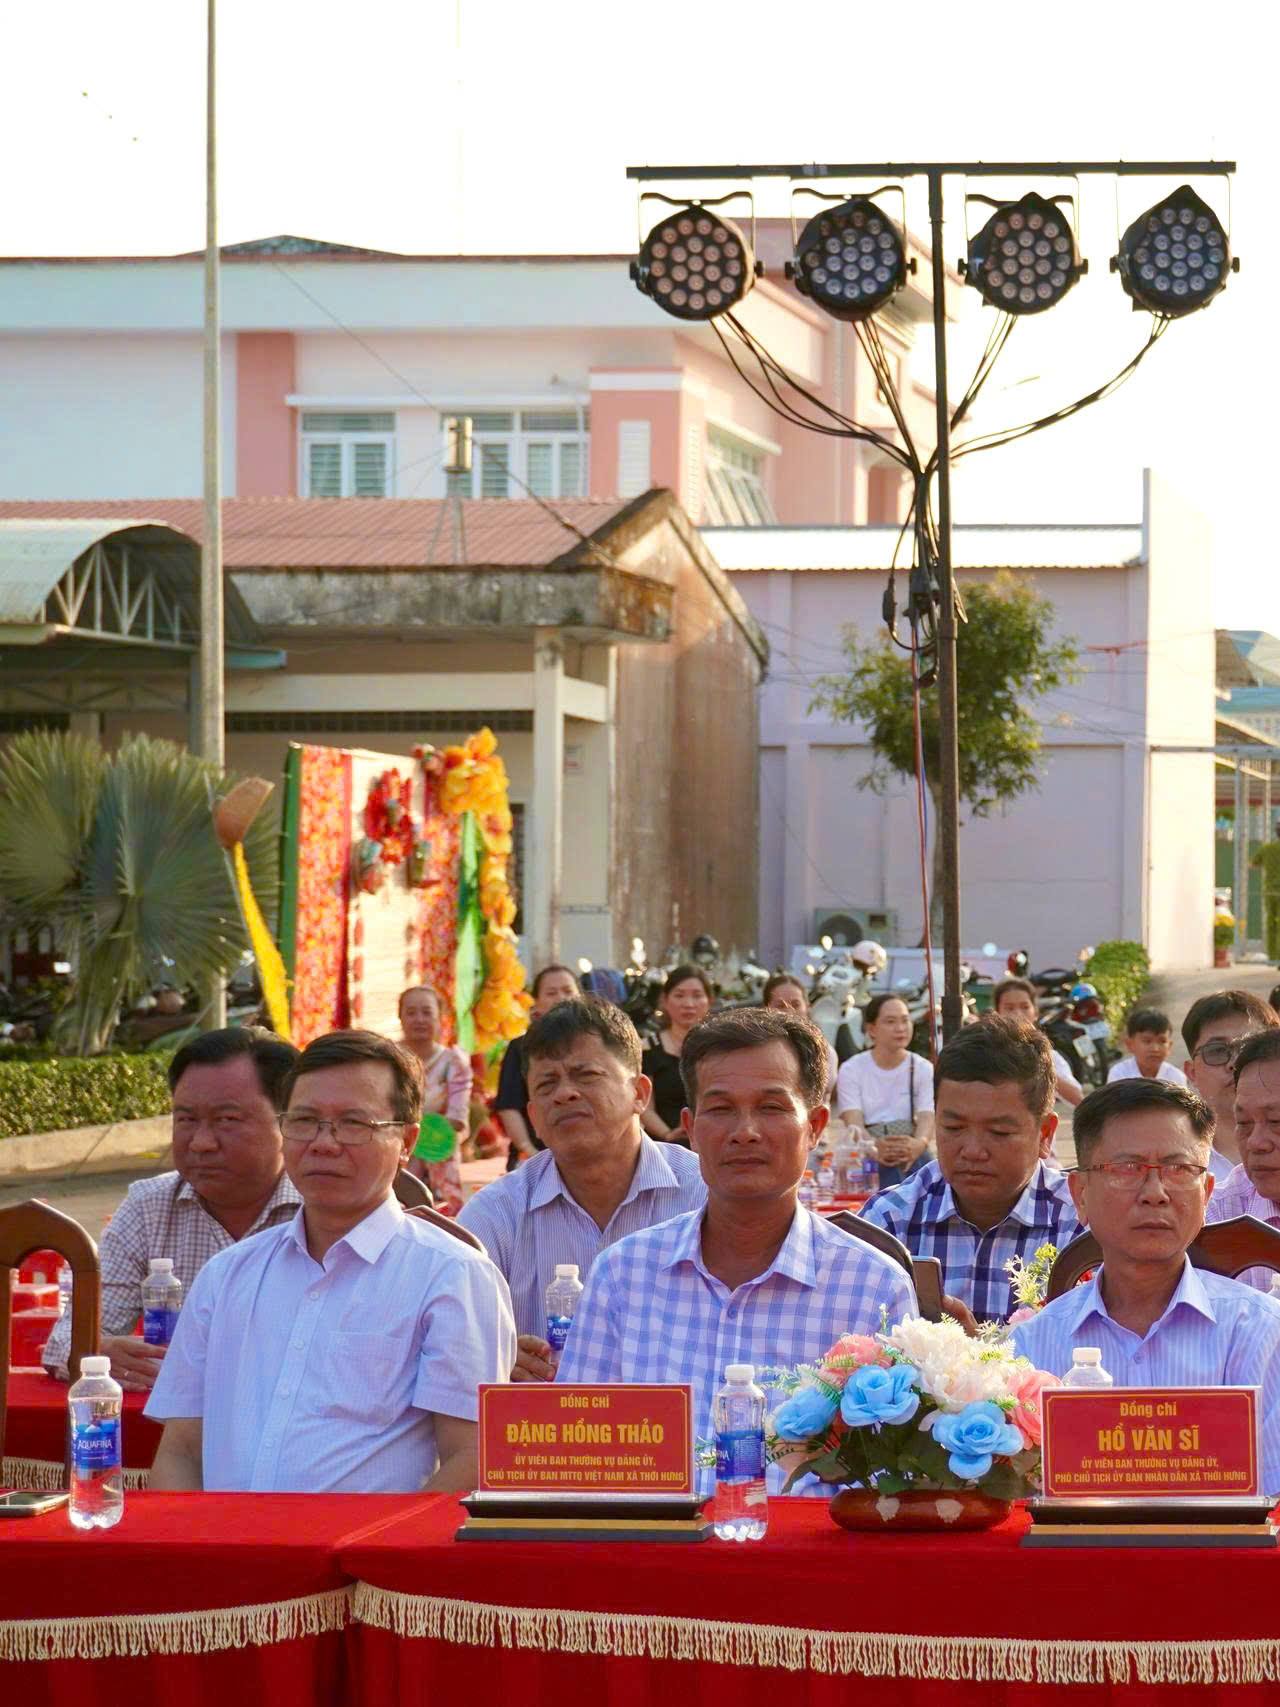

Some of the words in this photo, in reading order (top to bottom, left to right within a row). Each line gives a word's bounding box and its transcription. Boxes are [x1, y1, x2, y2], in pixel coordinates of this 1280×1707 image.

[560, 1394, 588, 1409] ĐỒNG
[592, 1395, 610, 1408] CHÍ
[1120, 1400, 1153, 1417] Đồng
[1156, 1401, 1176, 1416] chí
[506, 1420, 556, 1447] ĐẶNG
[562, 1418, 612, 1444] HỒNG
[617, 1418, 664, 1444] THẢO
[1098, 1423, 1125, 1450] HỒ
[1131, 1425, 1172, 1450] VĂN
[1179, 1425, 1199, 1450] SĨ
[77, 1439, 113, 1450] AQUAFINA
[549, 1456, 567, 1465] BAN
[1115, 1458, 1133, 1468] BAN
[540, 1471, 558, 1480] BAN
[604, 1471, 624, 1481] NAM
